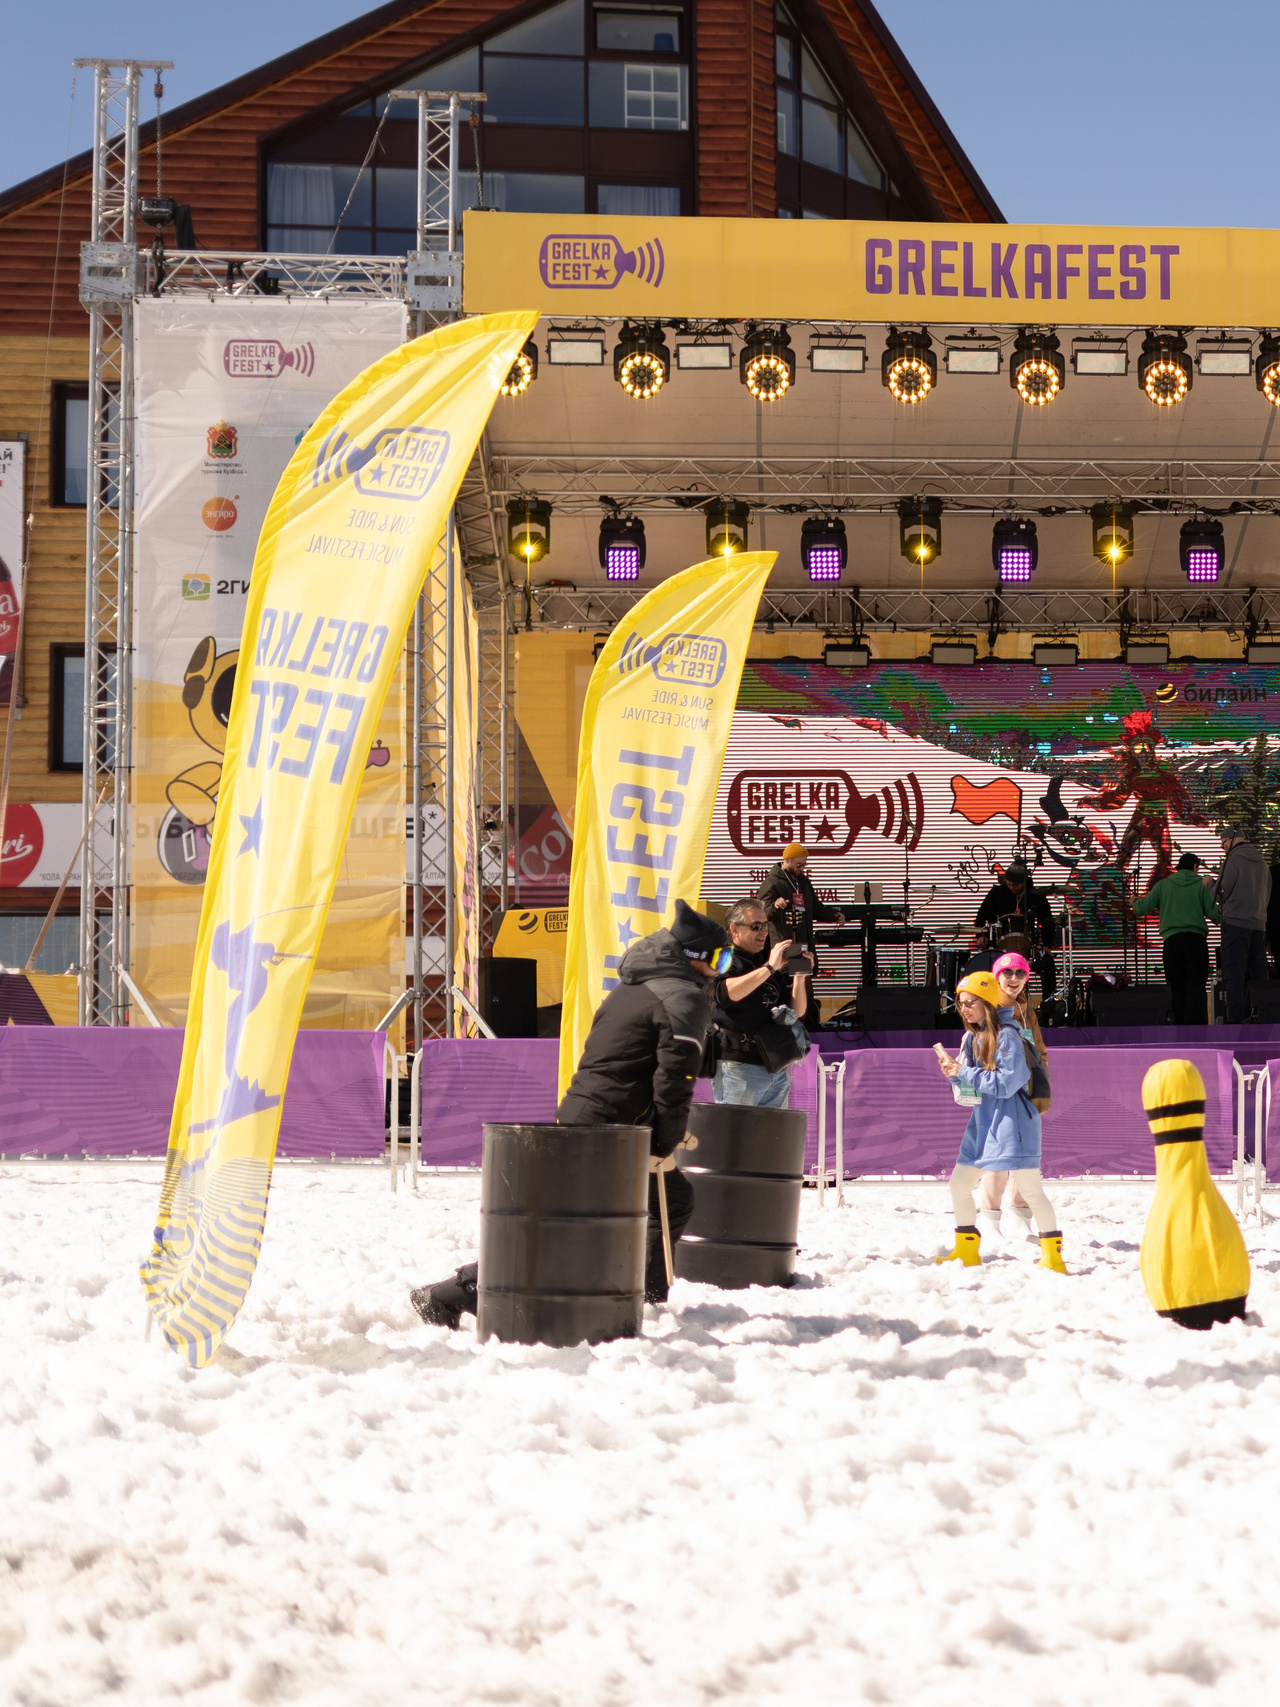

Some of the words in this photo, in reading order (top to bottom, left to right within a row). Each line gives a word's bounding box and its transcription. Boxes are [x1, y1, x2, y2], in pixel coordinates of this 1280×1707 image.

[551, 242, 611, 261] GRELKA
[552, 263, 592, 281] FEST
[865, 238, 1180, 301] GRELKAFEST
[233, 345, 276, 358] GRELKA
[233, 360, 262, 372] FEST
[217, 579, 250, 594] 2ГИ
[1183, 684, 1267, 702] билайн
[748, 782, 840, 810] GRELKA
[748, 815, 810, 843] FEST
[548, 914, 568, 922] GRELK
